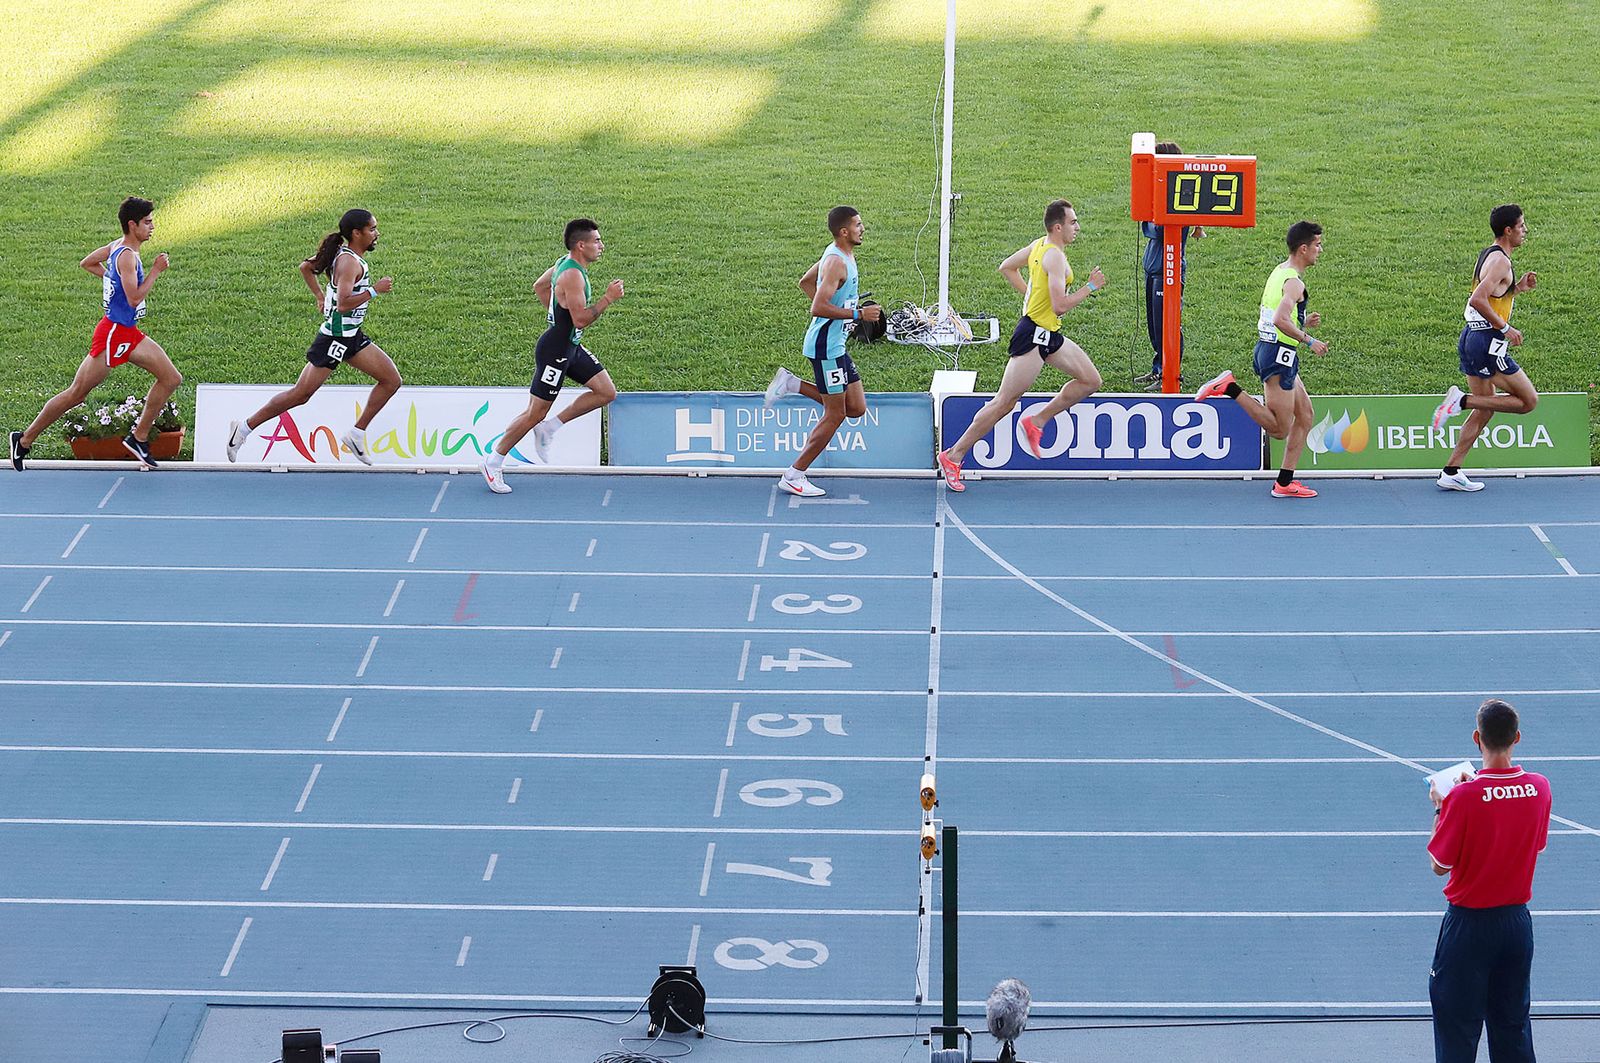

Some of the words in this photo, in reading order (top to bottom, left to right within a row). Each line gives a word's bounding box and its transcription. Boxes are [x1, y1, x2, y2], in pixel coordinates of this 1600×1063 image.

[1184, 163, 1227, 171] MONDO
[1173, 174, 1239, 212] 09
[1166, 244, 1174, 286] MONDO
[1038, 330, 1047, 343] 4
[331, 344, 345, 359] 15
[1281, 351, 1291, 363] 6
[1495, 341, 1504, 353] 7
[546, 369, 556, 382] 3
[831, 371, 840, 384] 5
[736, 407, 879, 427] DIPUTAN
[736, 433, 766, 452] DE
[774, 432, 867, 452] HULVA
[788, 494, 870, 508] 1
[779, 540, 867, 561] 2
[771, 593, 863, 614] 3
[759, 648, 853, 672] 4
[747, 713, 849, 737] 5
[738, 778, 844, 807] 6
[1482, 783, 1538, 802] Joma
[725, 857, 833, 886] 7
[713, 937, 829, 970] 8
